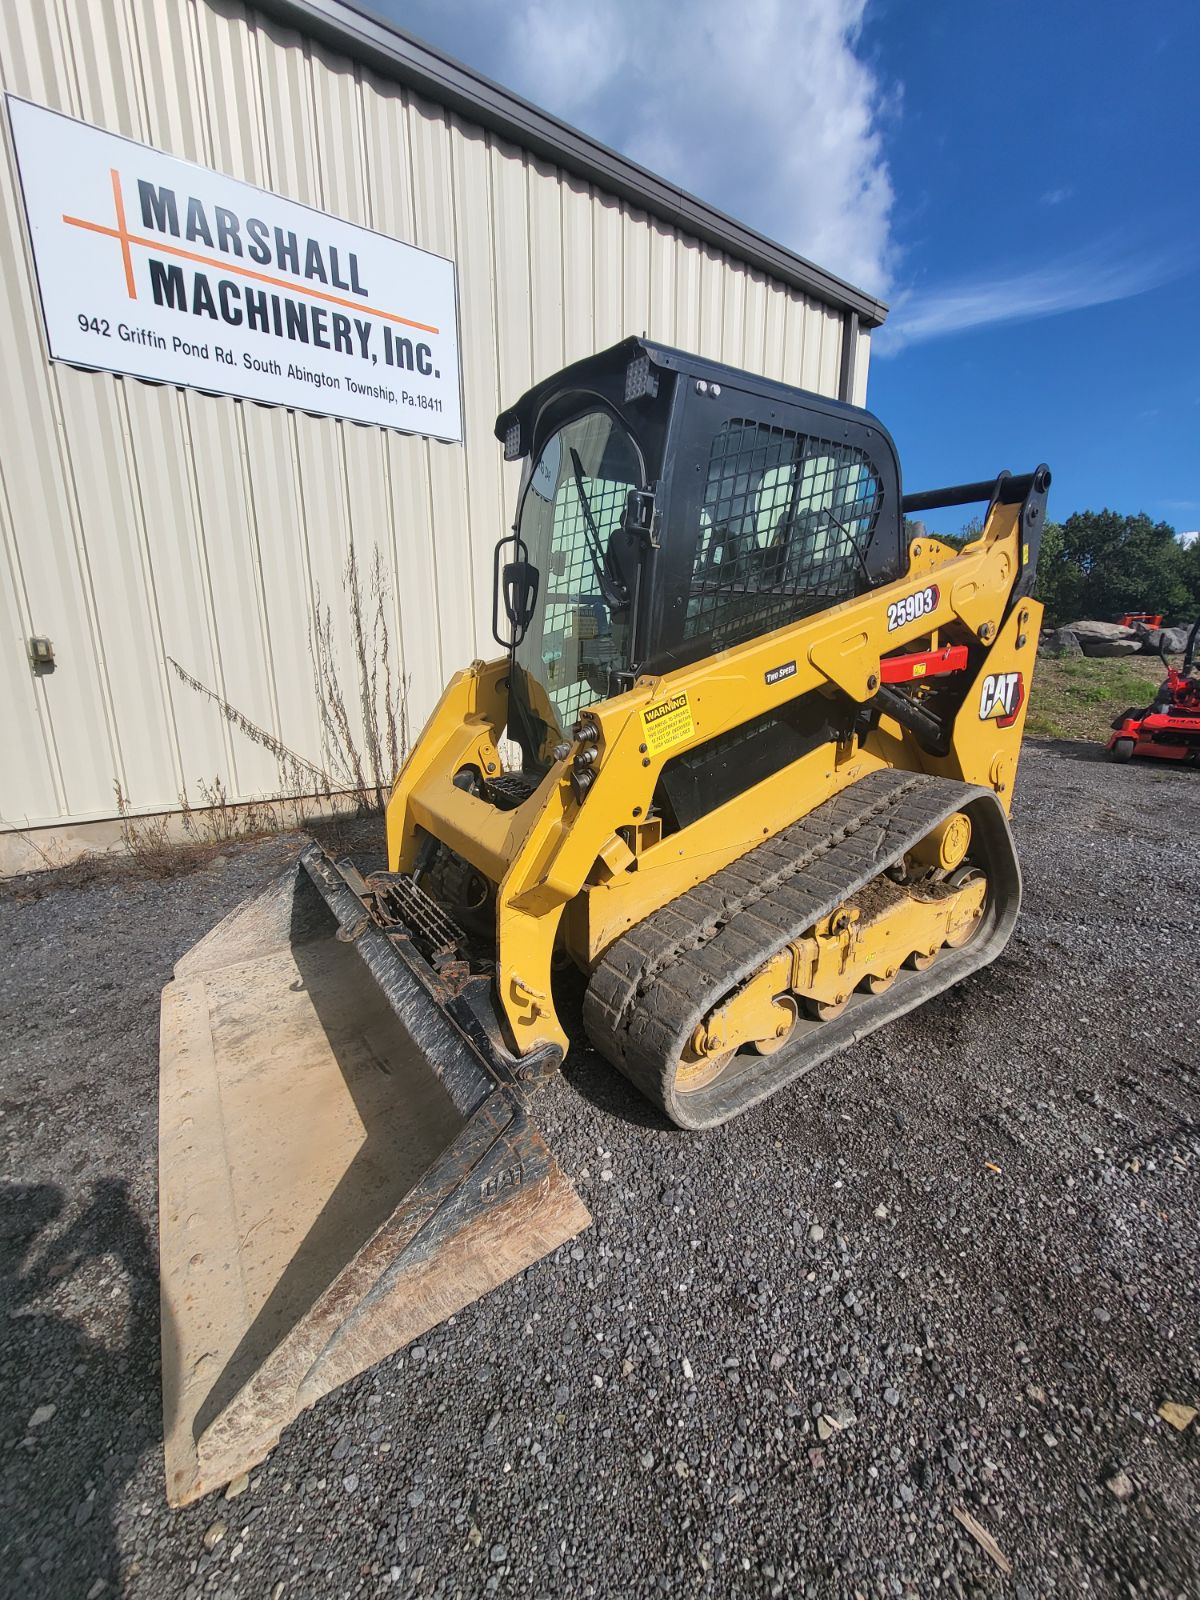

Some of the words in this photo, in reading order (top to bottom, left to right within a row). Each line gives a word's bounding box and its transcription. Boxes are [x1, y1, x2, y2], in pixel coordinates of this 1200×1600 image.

[137, 178, 369, 298] MARSHALL
[77, 313, 111, 338] 942
[118, 323, 167, 351] Griffin
[172, 336, 209, 361] Pond
[215, 345, 238, 367] Rd.
[243, 353, 282, 377] South
[287, 363, 341, 390] Abington
[344, 377, 398, 405] Township,
[401, 390, 443, 413] Pa.18411
[148, 257, 378, 366] MACHINERY,
[384, 326, 441, 378] Inc.
[887, 588, 933, 631] 259D3
[980, 673, 1018, 720] CAT
